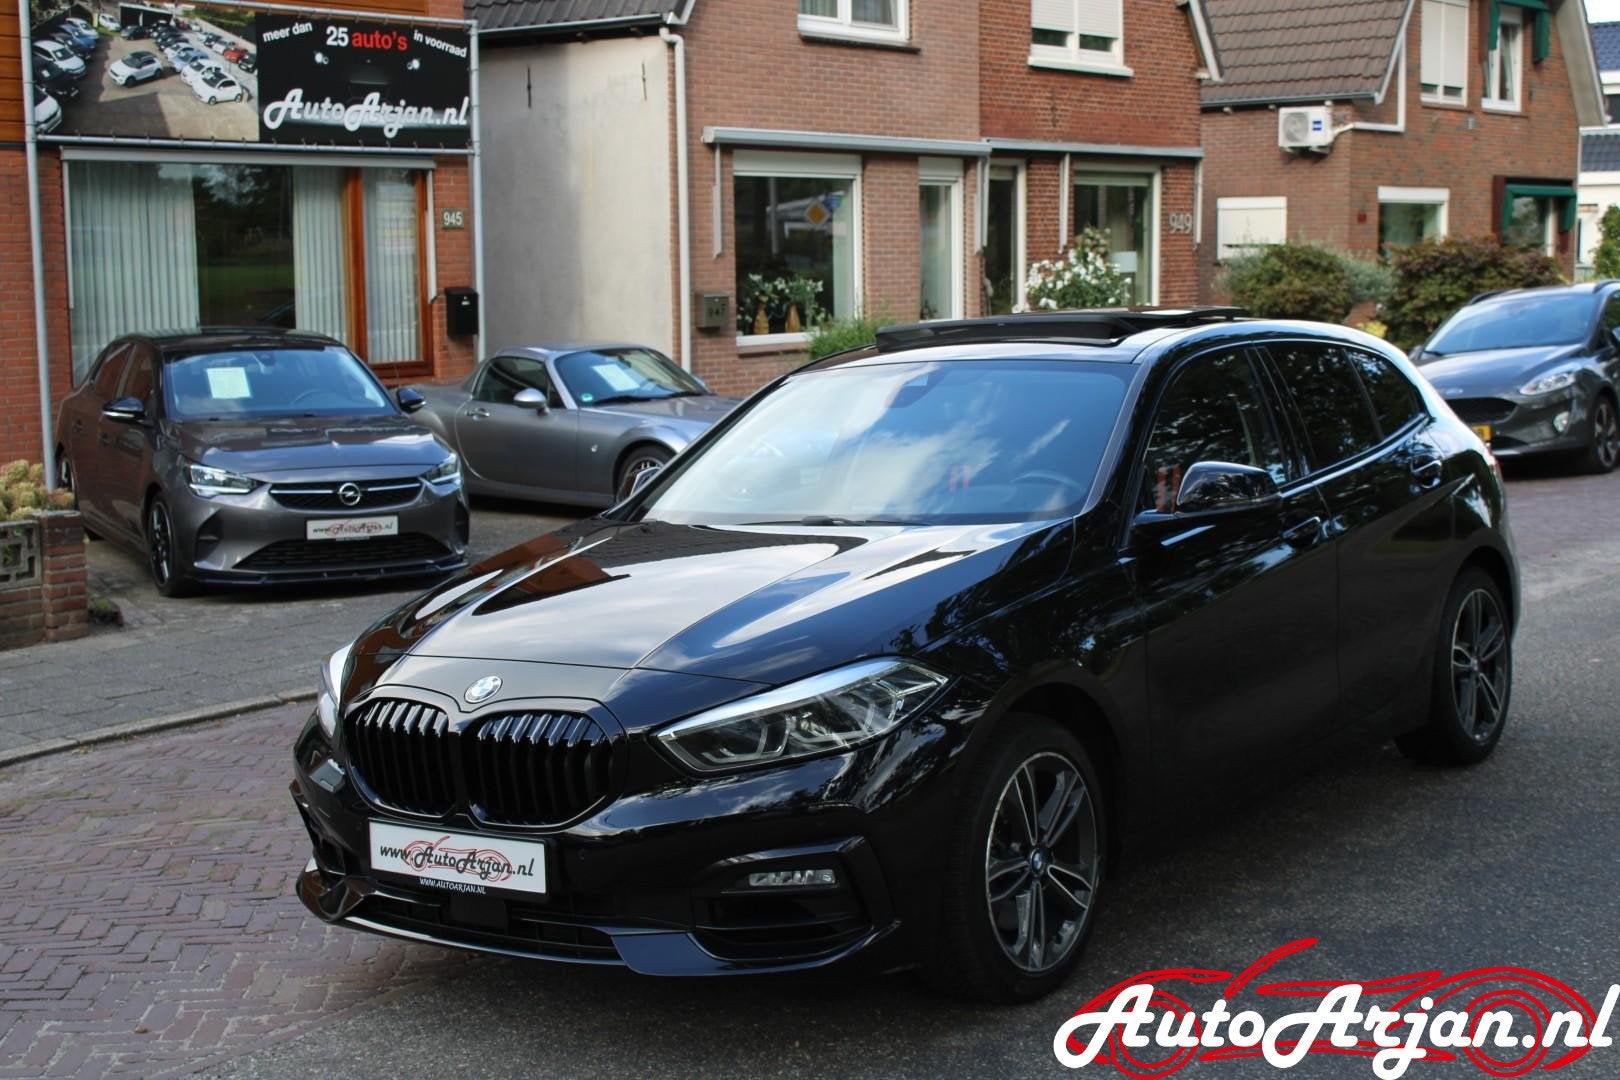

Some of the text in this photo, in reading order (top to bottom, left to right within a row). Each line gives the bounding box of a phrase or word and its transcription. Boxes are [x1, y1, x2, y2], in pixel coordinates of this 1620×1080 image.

[262, 22, 468, 58] meer dan 25 auto's in voorraad
[263, 88, 470, 138] AutoArjan.nl
[443, 211, 463, 226] 945
[1169, 213, 1192, 234] 949
[380, 845, 535, 880] www.AutoArjan.nl
